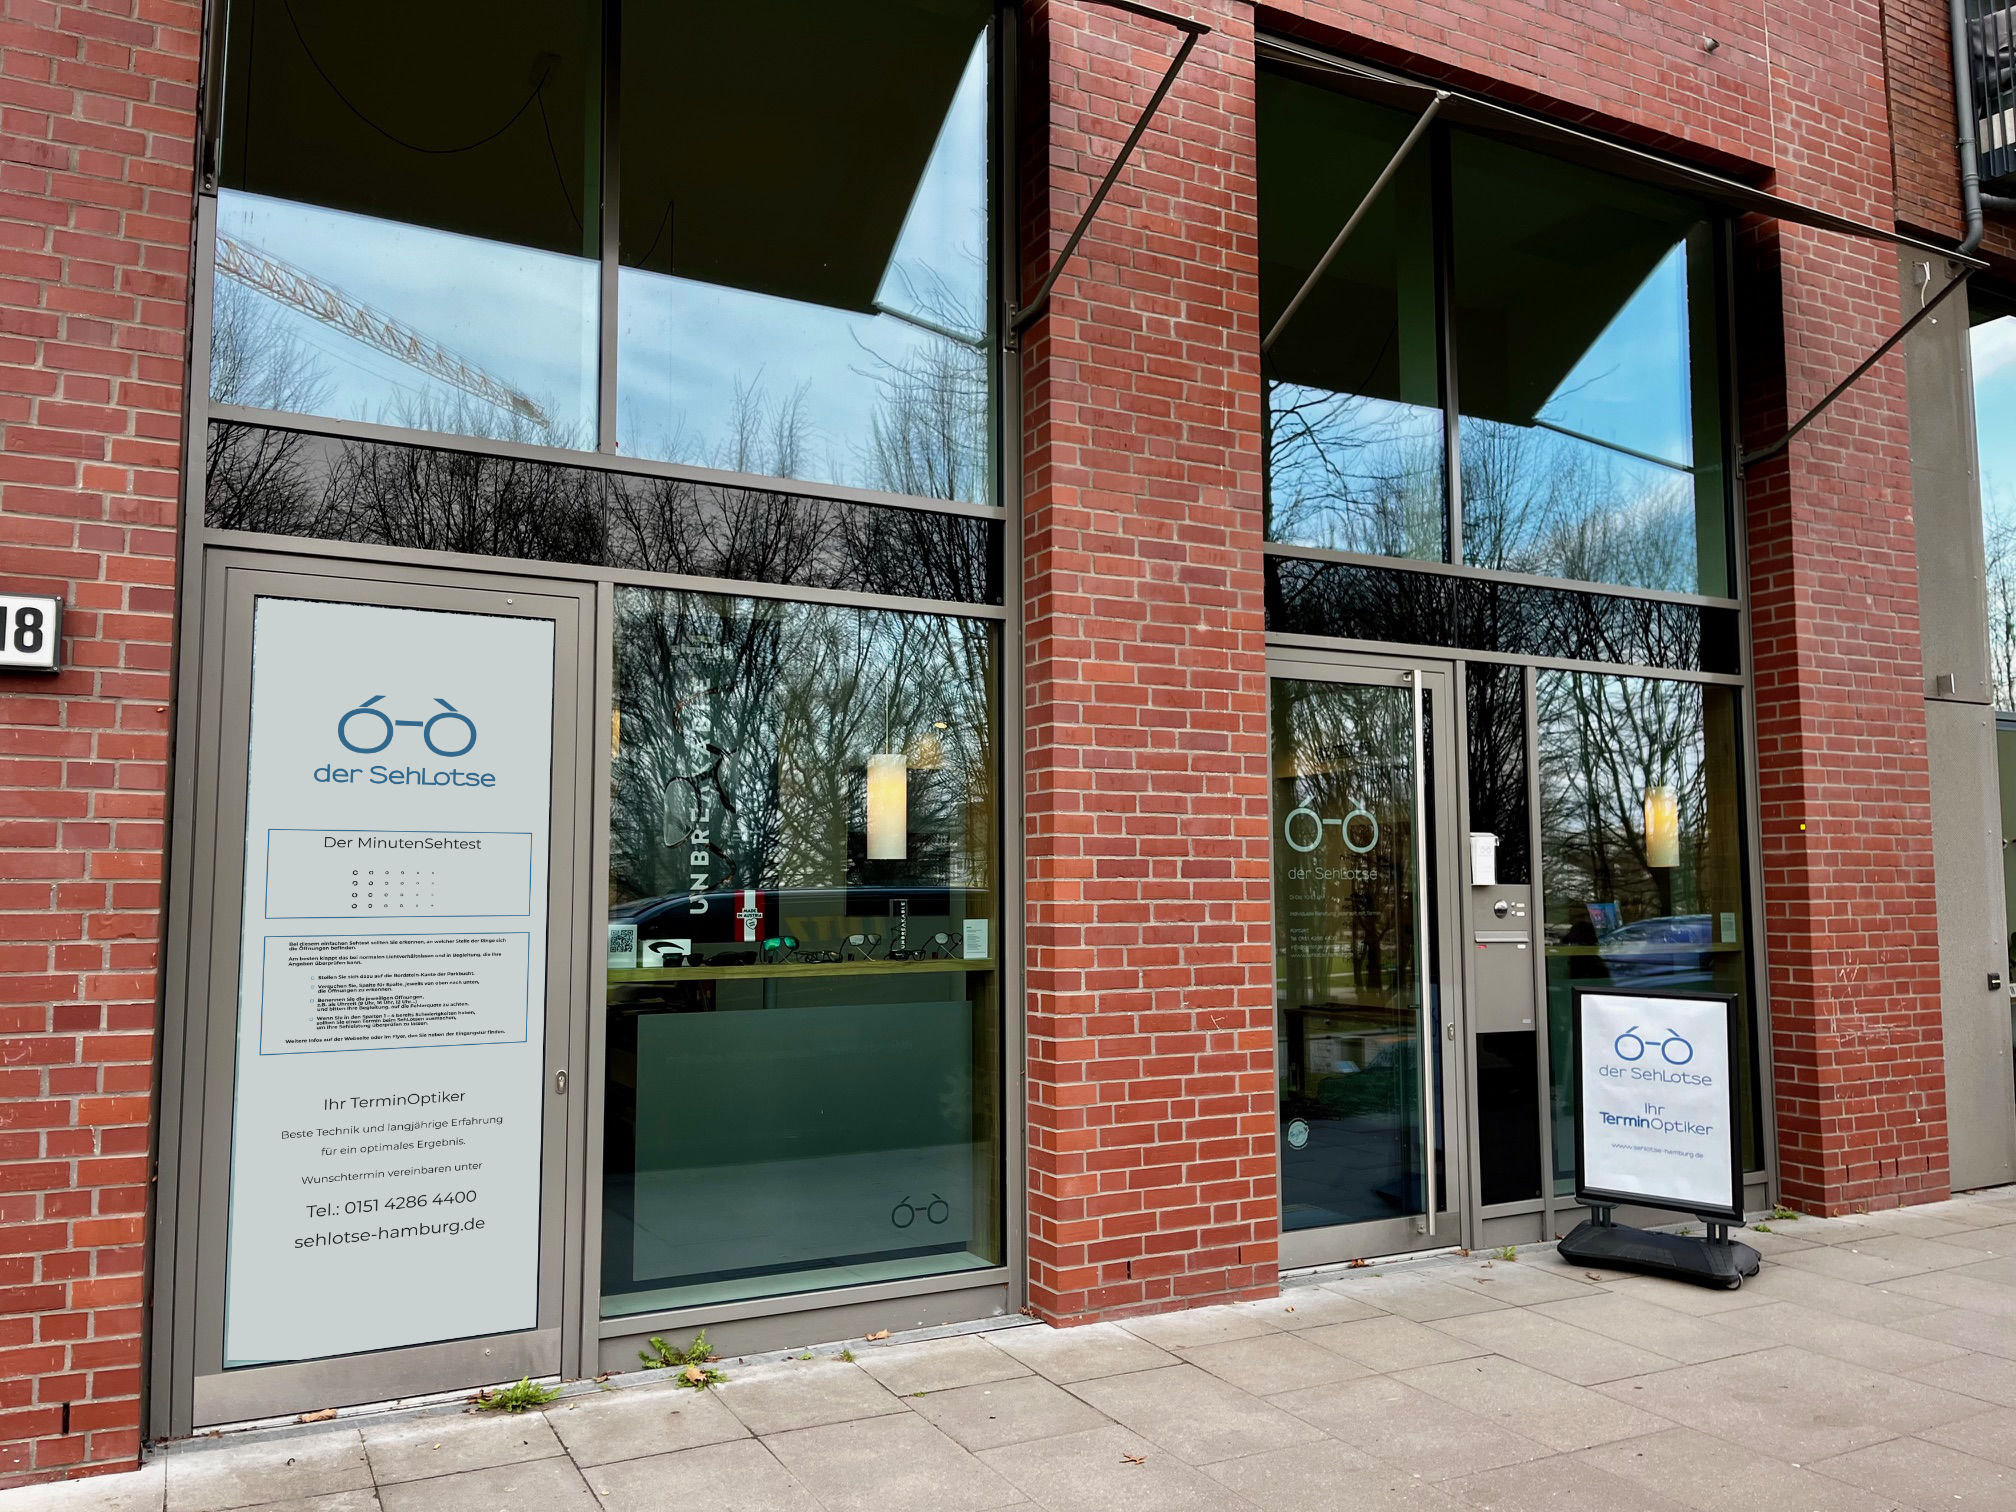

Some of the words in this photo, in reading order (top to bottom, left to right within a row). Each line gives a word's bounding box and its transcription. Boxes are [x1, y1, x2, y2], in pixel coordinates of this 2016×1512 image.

[314, 764, 363, 783] der
[370, 766, 495, 787] SehLotse
[325, 837, 353, 848] Der
[359, 837, 481, 849] MinutenSehtest
[1288, 867, 1311, 880] der
[1315, 867, 1378, 880] SehLotse
[1599, 1065, 1627, 1078] der
[1631, 1067, 1712, 1086] SehLotse
[325, 1099, 346, 1110] Ihr
[350, 1091, 465, 1108] TerminOptiker
[1644, 1103, 1665, 1115] Ihr
[282, 1131, 313, 1139] Beste
[316, 1126, 359, 1136] Technik
[363, 1124, 384, 1133] und
[388, 1120, 448, 1131] langjährige
[452, 1117, 502, 1126] Erfahrung
[1599, 1112, 1713, 1135] TerminOptiker
[340, 1146, 356, 1154] ein
[360, 1142, 414, 1154] optimales
[418, 1138, 465, 1149] Ergebnis.
[1611, 1143, 1704, 1159] www.sehlotse-hamburg.de
[302, 1170, 384, 1184] Wunschtermin
[388, 1166, 451, 1177] vereinbaren
[455, 1163, 482, 1171] unter
[306, 1203, 339, 1217] Tel.:
[345, 1199, 378, 1214] 0151
[385, 1195, 427, 1209] 4286
[433, 1190, 476, 1205] 4400
[295, 1218, 485, 1248] sehlotse-hamburg.de
